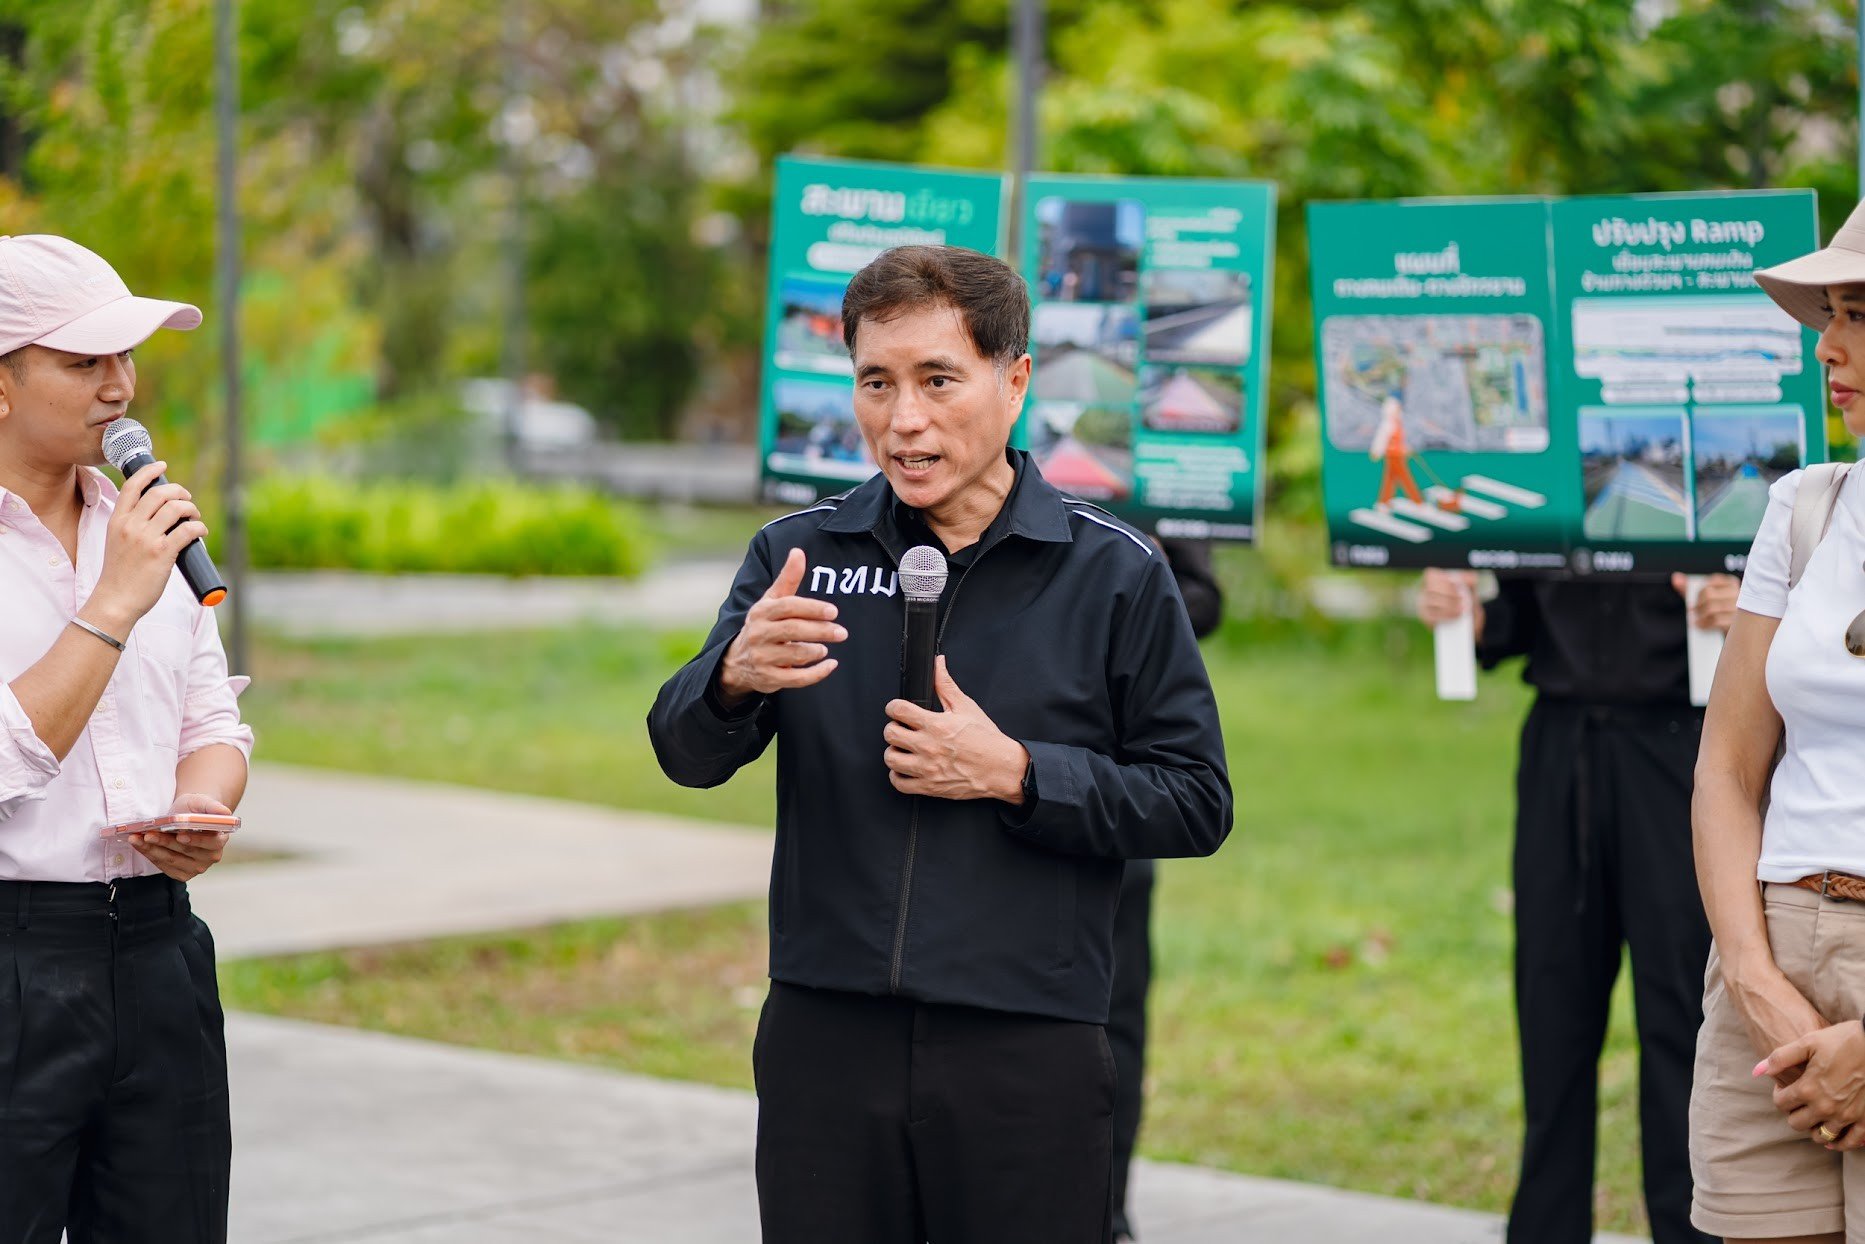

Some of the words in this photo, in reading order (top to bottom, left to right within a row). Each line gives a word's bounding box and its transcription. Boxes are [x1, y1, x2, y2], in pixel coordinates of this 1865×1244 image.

[1592, 217, 1686, 251] ปรับปรุง
[1691, 218, 1765, 247] Ramp
[810, 565, 899, 598] กทม
